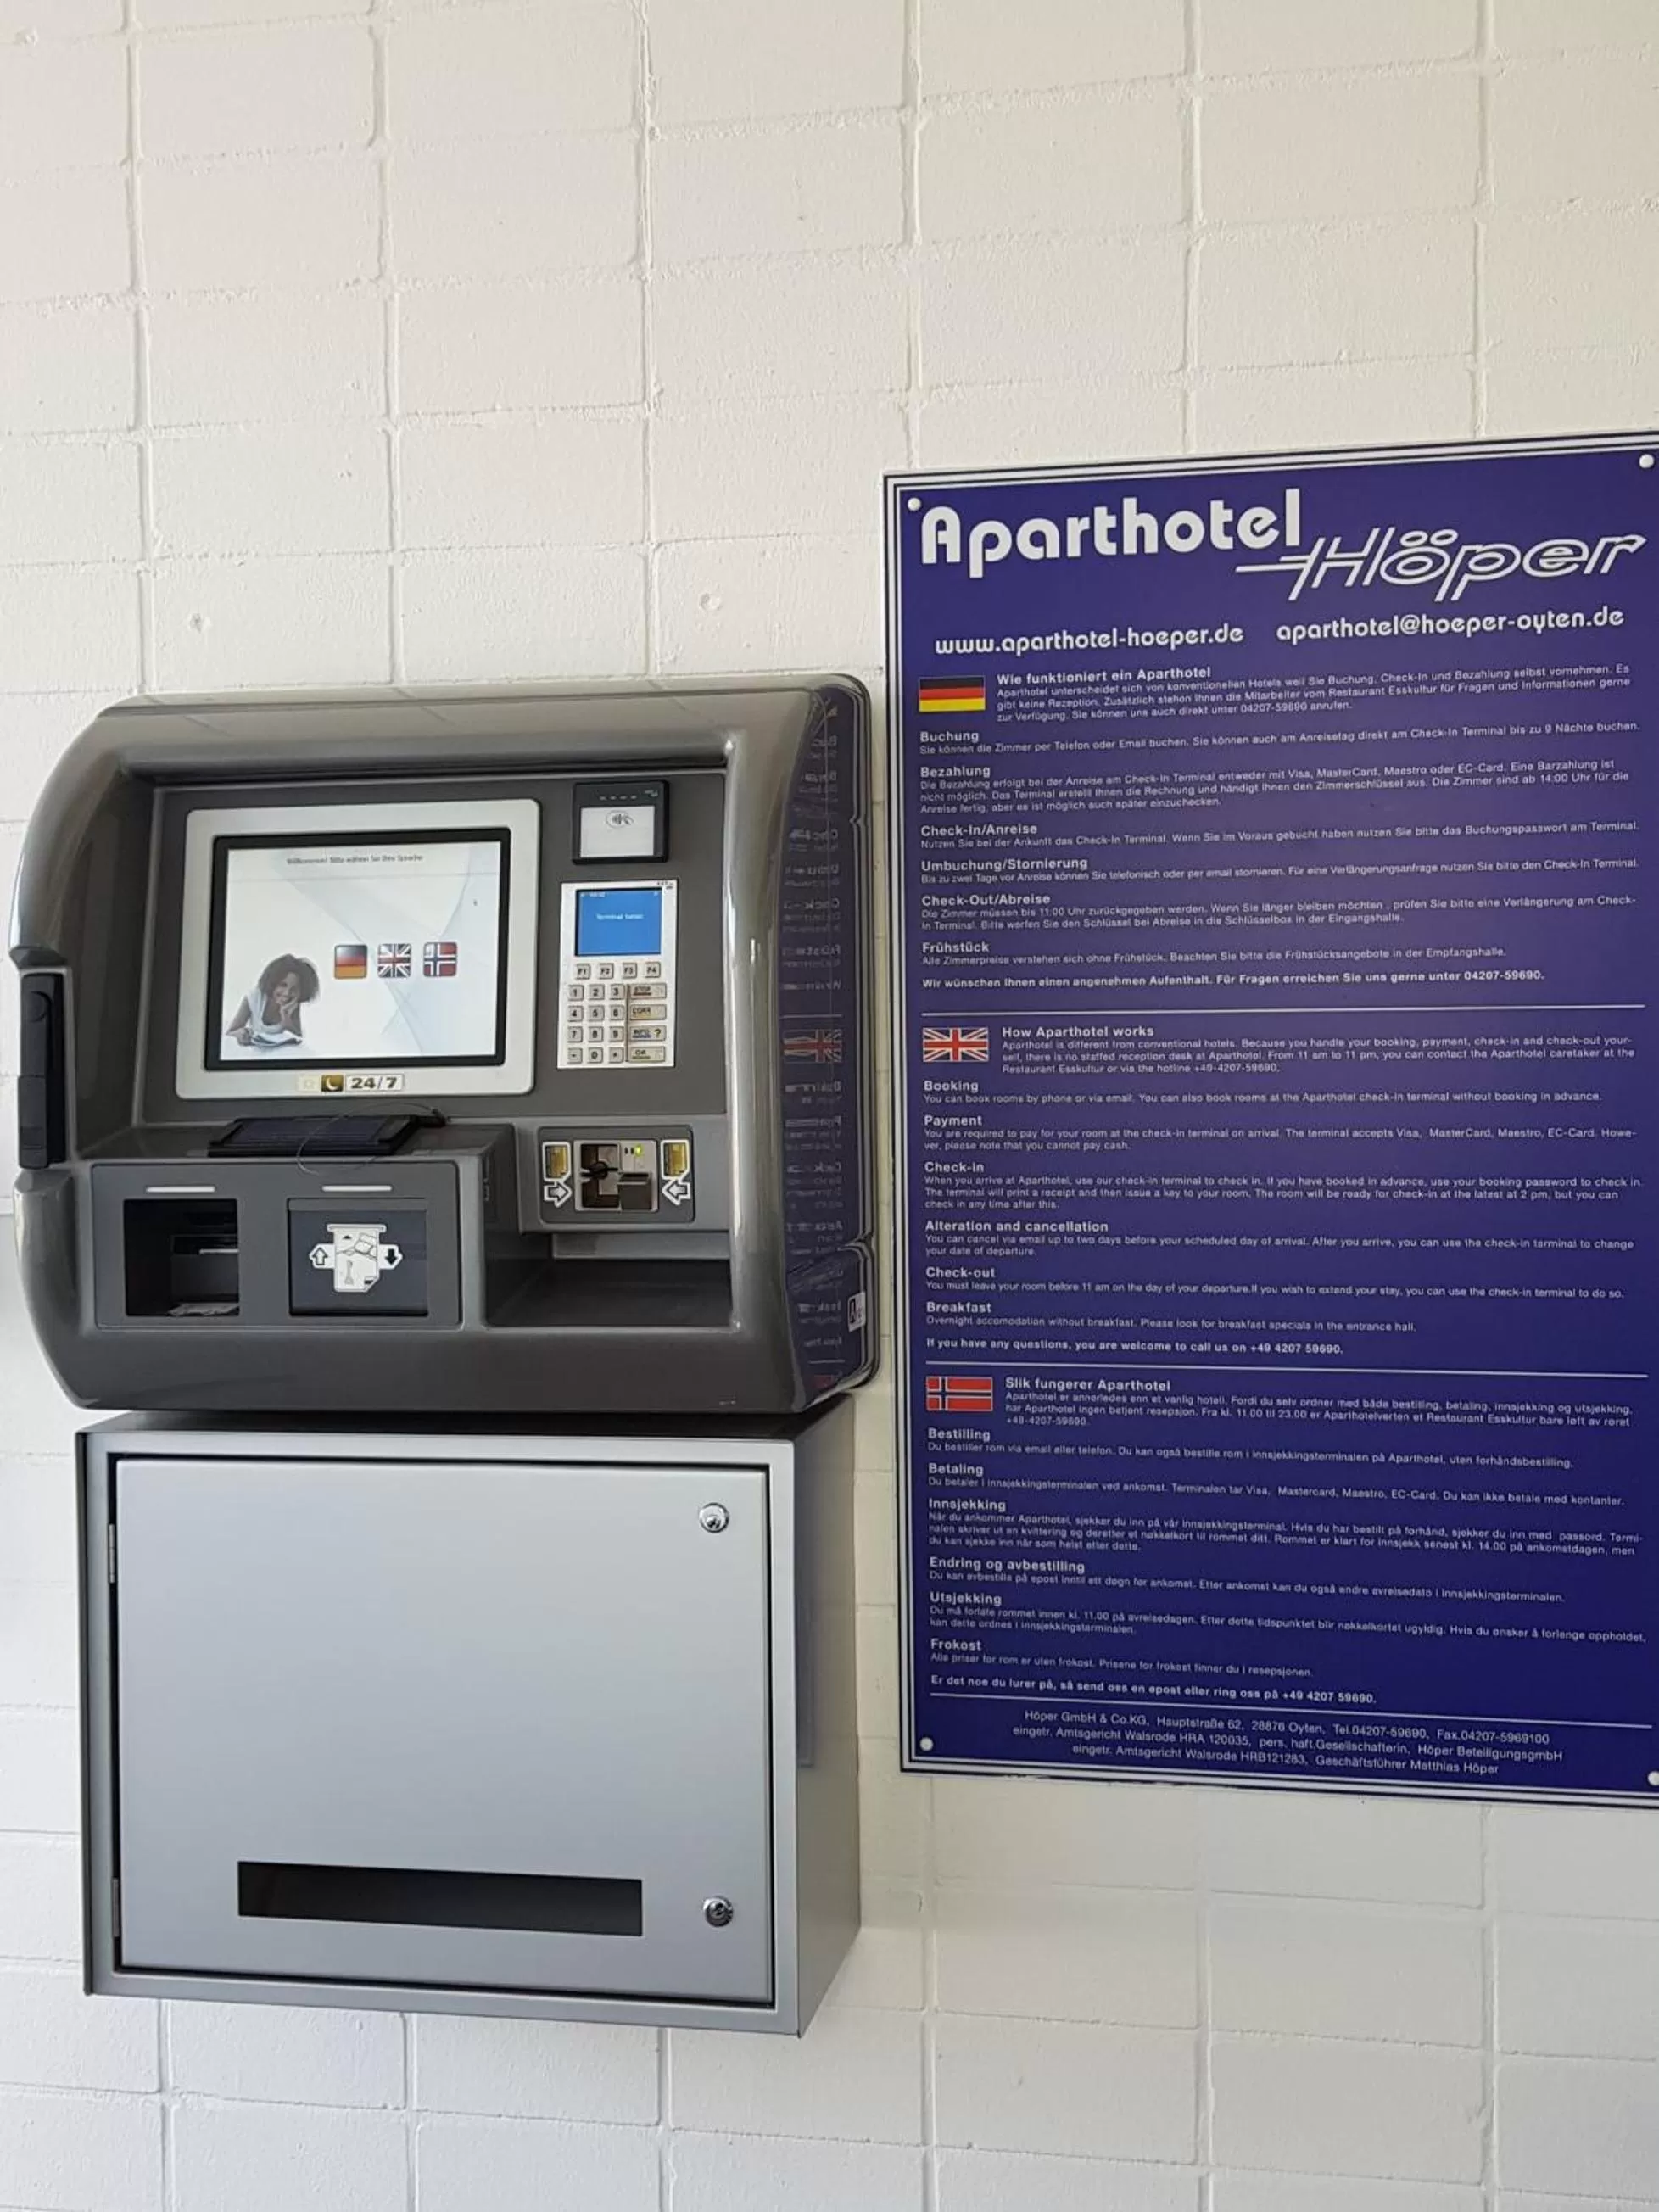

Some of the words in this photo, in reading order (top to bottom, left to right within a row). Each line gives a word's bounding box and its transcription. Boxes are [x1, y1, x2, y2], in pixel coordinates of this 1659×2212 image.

[921, 489, 1301, 578] Aparthotel
[1236, 526, 1647, 602] Höper
[1276, 606, 1625, 645] aparthotel@hoeper-oyten.de
[935, 624, 1244, 656] www.aparthotel-hoeper.de
[997, 673, 1021, 684] Wie
[1026, 671, 1107, 684] funktioniert
[1111, 670, 1131, 681] ein
[1136, 668, 1210, 683] Aparthotel
[920, 730, 979, 744] Buchung
[920, 766, 990, 779] Bezahlung
[921, 824, 1038, 835] Check-In/Anreise
[921, 858, 1088, 873] Umbuchung/Stornierung
[921, 894, 1051, 905] Check-Out/Abreise
[922, 941, 989, 952] Frühstück
[922, 978, 941, 987] Wir
[944, 978, 1000, 986] wünschen
[1004, 977, 1035, 986] Ihnen
[1038, 977, 1070, 986] einen
[1072, 976, 1146, 987] angenehmen
[1149, 975, 1212, 985] Aufenthalt.
[1216, 975, 1235, 984] Für
[1239, 975, 1279, 986] Fragen
[1282, 974, 1339, 983] erreichen
[1343, 974, 1361, 982] Sie
[1390, 975, 1425, 984] gerne
[1428, 972, 1461, 981] unter
[1464, 971, 1544, 980] 04207-59690.
[1003, 1026, 1031, 1037] How
[1036, 1026, 1108, 1039] Aparthotel
[1113, 1025, 1153, 1036] works
[351, 1076, 398, 1089] 24/7
[924, 1080, 978, 1092] Booking
[924, 1115, 981, 1127] Payment
[924, 1162, 984, 1172] Check-in
[924, 1221, 991, 1231] Alteration
[996, 1221, 1020, 1231] and
[1025, 1221, 1108, 1232] cancellation
[926, 1267, 997, 1277] Check-out
[926, 1301, 992, 1312] Breakfast
[926, 1338, 934, 1347] If
[937, 1340, 958, 1349] you
[960, 1339, 986, 1348] have
[990, 1341, 1009, 1350] any
[1013, 1340, 1071, 1351] questions,
[1075, 1343, 1095, 1351] you
[1120, 1341, 1171, 1350] welcome
[1175, 1342, 1187, 1350] to
[1190, 1343, 1211, 1351] call
[1250, 1343, 1271, 1352] +49
[1274, 1343, 1301, 1352] 4207
[1305, 1343, 1343, 1353] 59690.
[1006, 1377, 1030, 1388] Slik
[1035, 1378, 1093, 1392] fungerer
[1097, 1379, 1170, 1393] Aparthotel
[927, 1427, 991, 1441] Bestilling
[928, 1462, 984, 1476] Betaling
[928, 1499, 1005, 1511] Innsjekking
[930, 1557, 980, 1571] Endring
[986, 1561, 1003, 1571] og
[1007, 1559, 1085, 1573] avbestilling
[930, 1592, 1002, 1606] Utsjekking
[931, 1639, 981, 1650] Frokost
[930, 1675, 943, 1684] Er
[946, 1676, 964, 1685] det
[991, 1678, 1006, 1687] du
[1008, 1679, 1035, 1688] lurer
[1039, 1679, 1056, 1690] på,
[1060, 1680, 1073, 1690] så
[1076, 1681, 1103, 1690] send
[1148, 1684, 1181, 1695] epost
[1184, 1685, 1209, 1695] eller
[1213, 1687, 1236, 1698] ring
[1264, 1689, 1278, 1700] på
[1282, 1690, 1303, 1699] +49
[1306, 1690, 1333, 1701] 4207
[1338, 1692, 1376, 1702] 59690.
